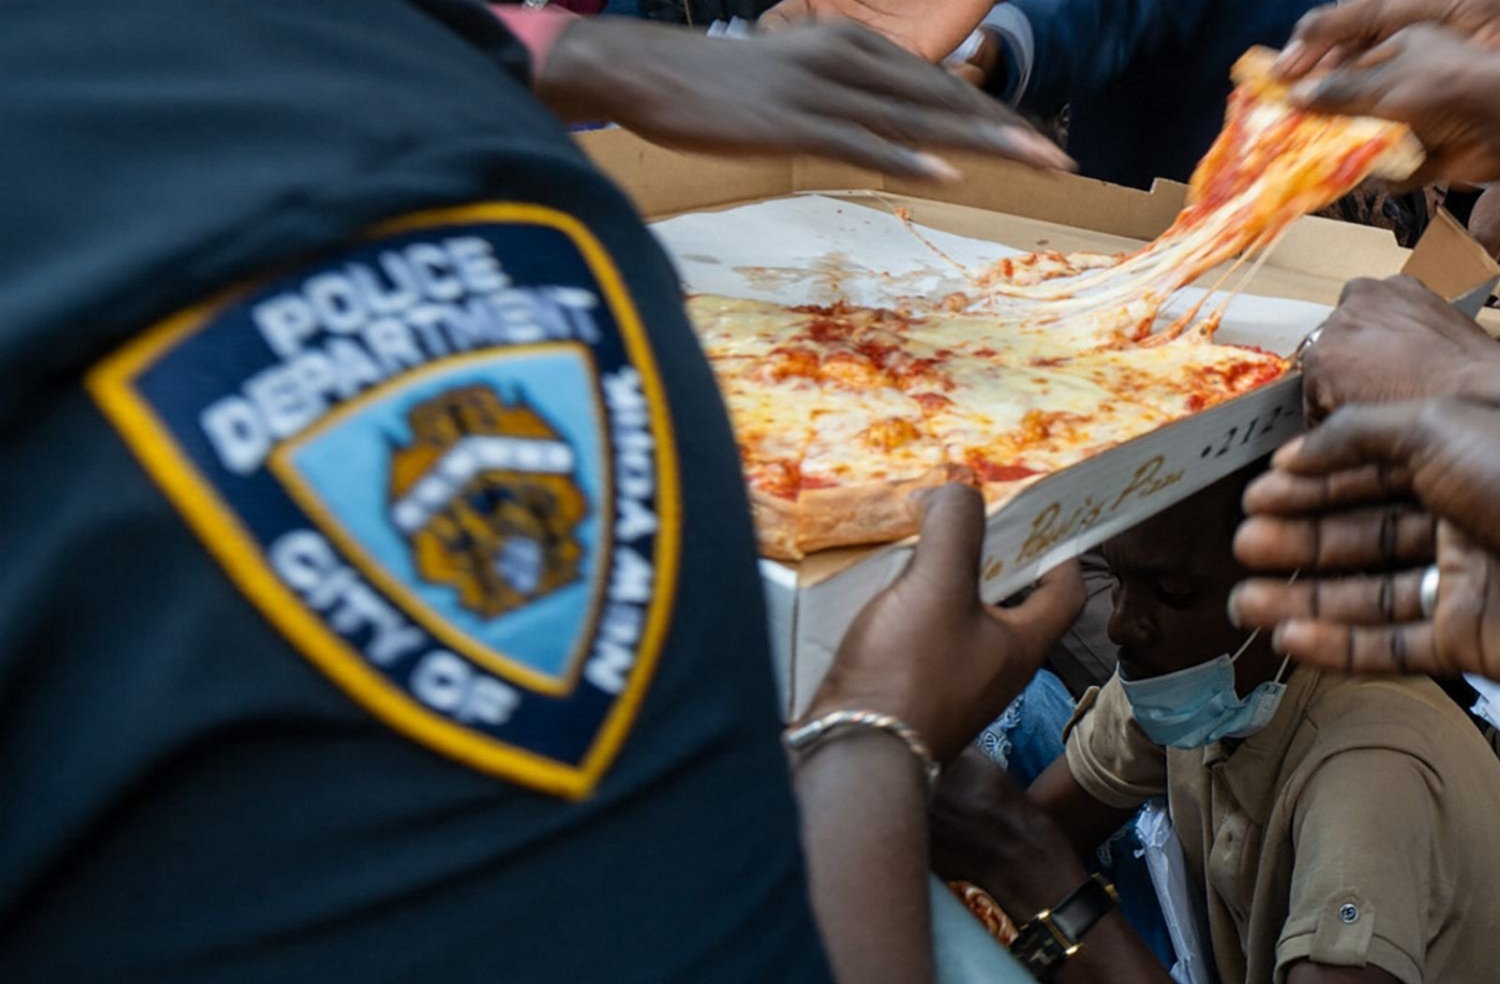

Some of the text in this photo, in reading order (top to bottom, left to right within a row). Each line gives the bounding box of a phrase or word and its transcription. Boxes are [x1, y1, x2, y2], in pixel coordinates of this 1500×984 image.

[200, 285, 601, 475] DEPARTMENT
[253, 236, 512, 357] POLICE
[585, 364, 659, 695] NEW YORK
[270, 529, 520, 724] CITY OF
